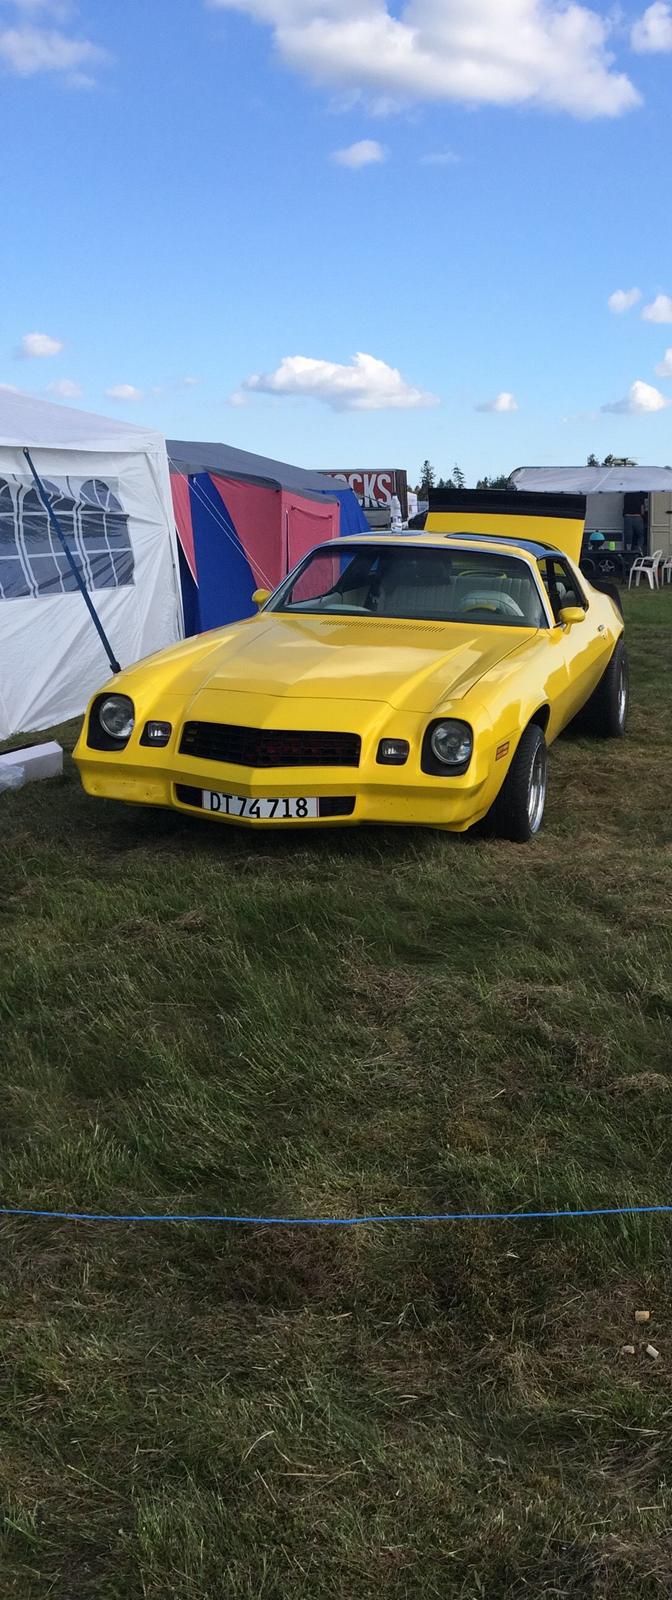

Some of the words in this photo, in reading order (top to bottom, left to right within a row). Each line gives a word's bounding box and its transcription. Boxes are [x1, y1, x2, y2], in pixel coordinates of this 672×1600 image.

[210, 792, 232, 814] DT
[238, 797, 260, 818] 74
[267, 797, 308, 818] 718
